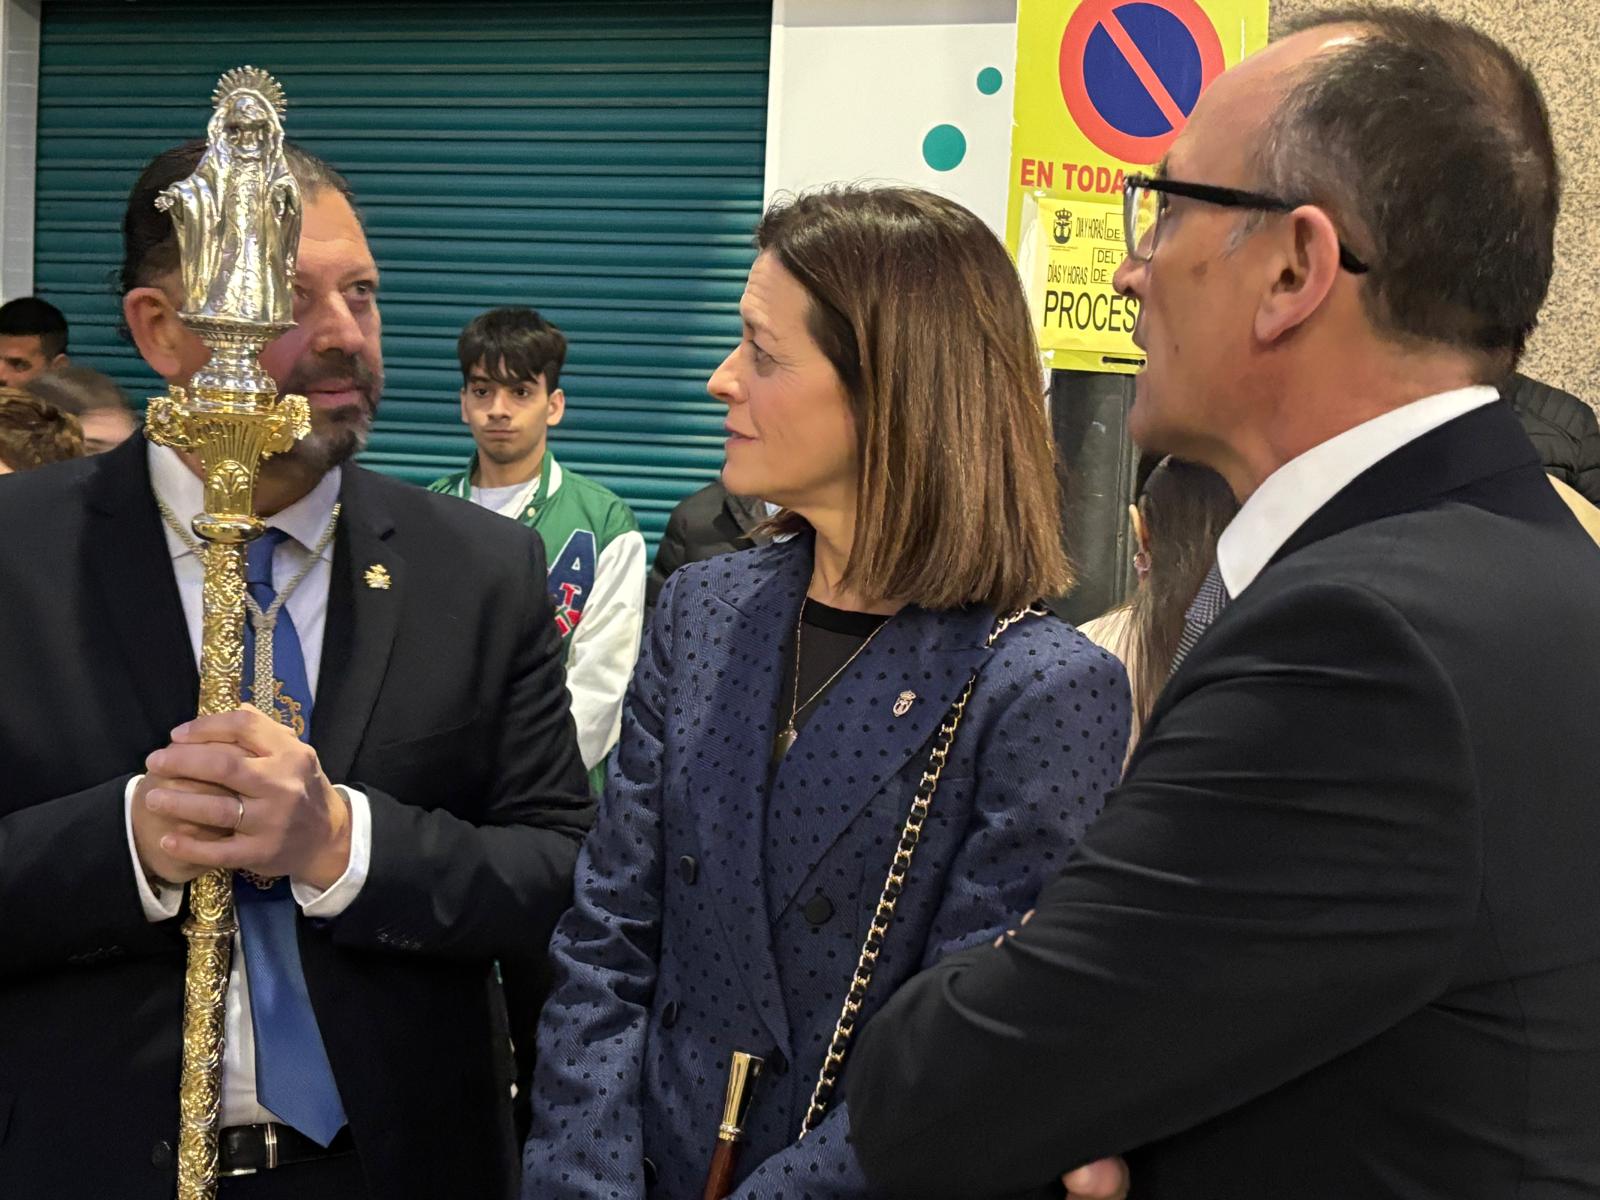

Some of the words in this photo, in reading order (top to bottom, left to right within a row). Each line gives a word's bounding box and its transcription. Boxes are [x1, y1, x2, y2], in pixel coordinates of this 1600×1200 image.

[1020, 158, 1054, 189] EN
[1062, 163, 1124, 195] TODA
[1088, 218, 1104, 239] HORAS
[1097, 249, 1116, 264] DEL
[1062, 265, 1068, 283] Y
[1067, 266, 1088, 285] HORAS
